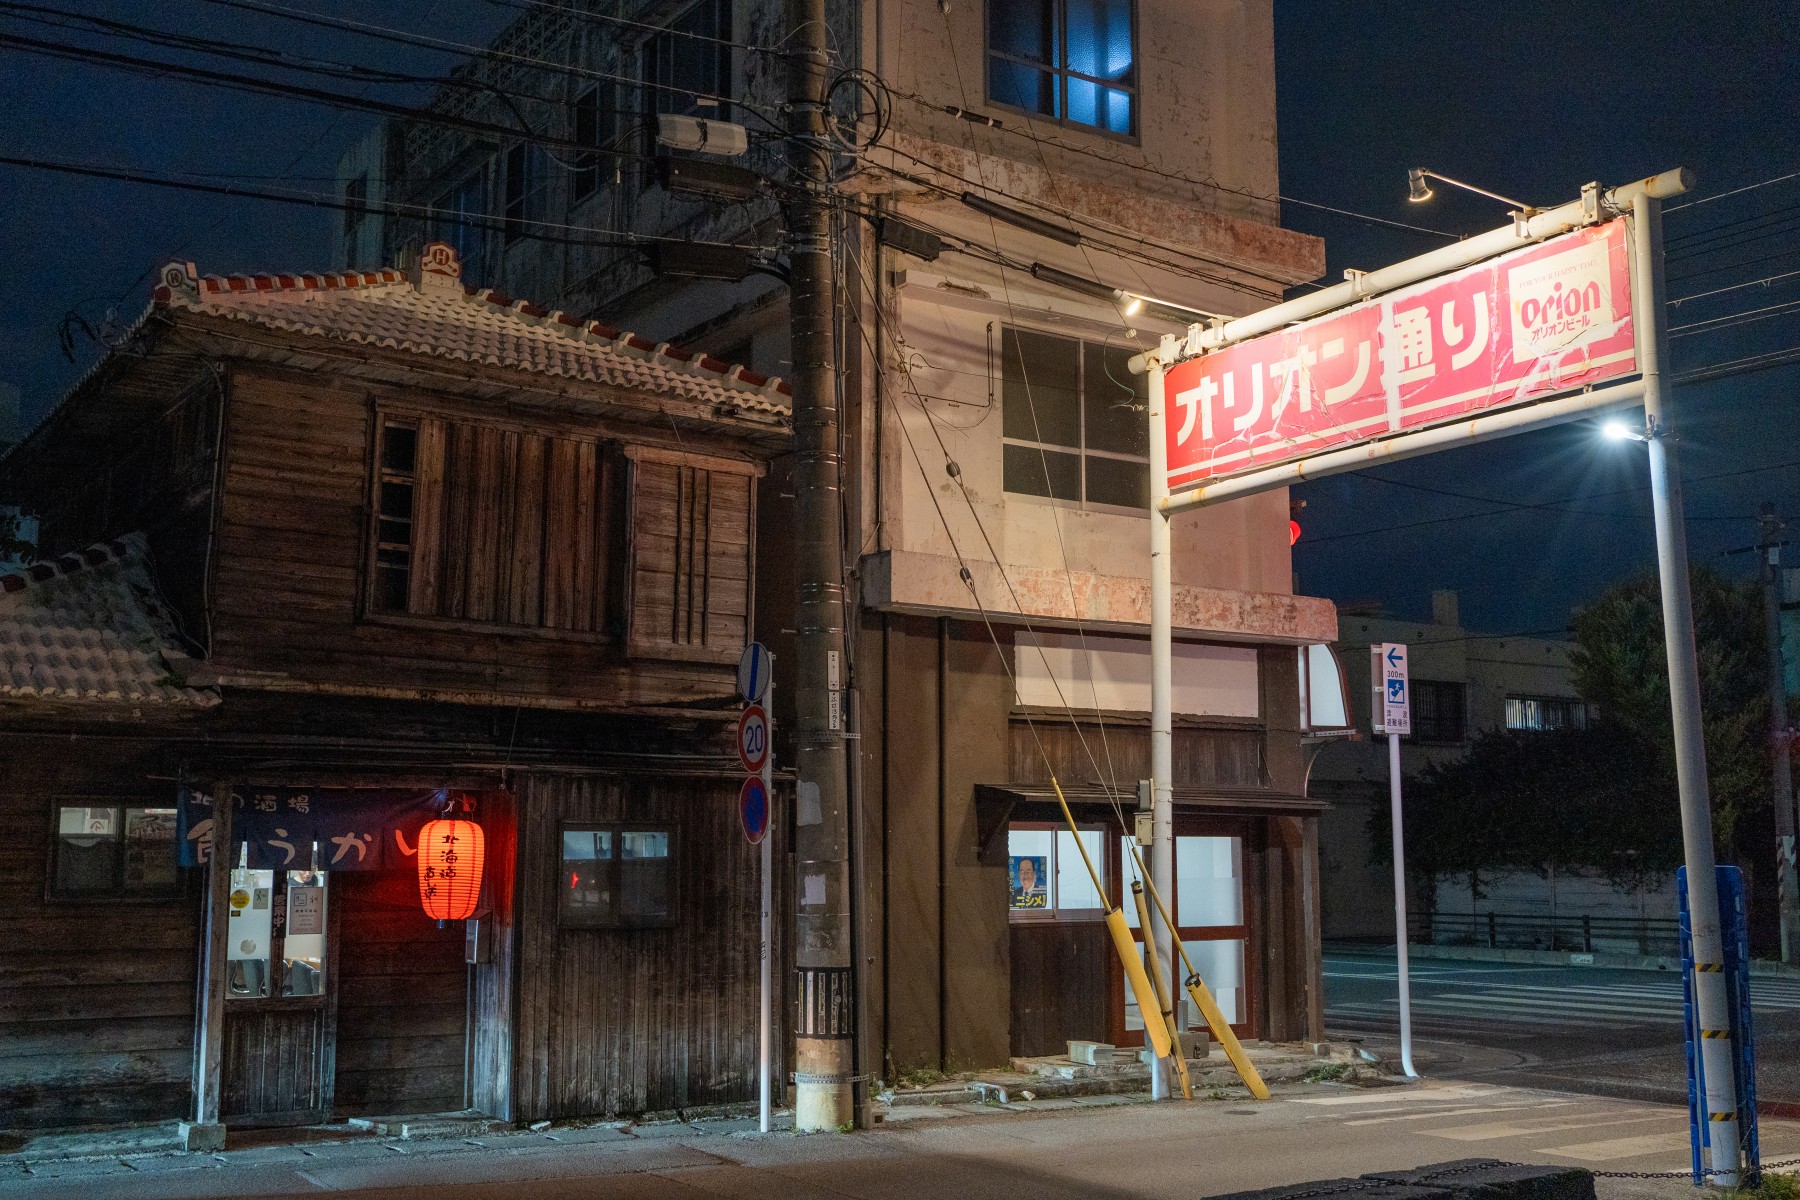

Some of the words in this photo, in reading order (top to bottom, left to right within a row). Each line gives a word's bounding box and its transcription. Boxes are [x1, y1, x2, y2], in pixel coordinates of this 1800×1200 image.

[1520, 280, 1532, 288] FOR
[1534, 273, 1553, 284] YOUR
[1554, 265, 1578, 279] HAPPY
[1580, 259, 1598, 270] TIME
[1521, 281, 1600, 328] orion
[1531, 314, 1590, 342] オリオンビール
[1176, 291, 1488, 446] オリオン通り
[746, 725, 763, 754] 20
[440, 834, 459, 878] 北海道
[424, 866, 437, 899] 直送
[1016, 895, 1042, 906] ニシメ
